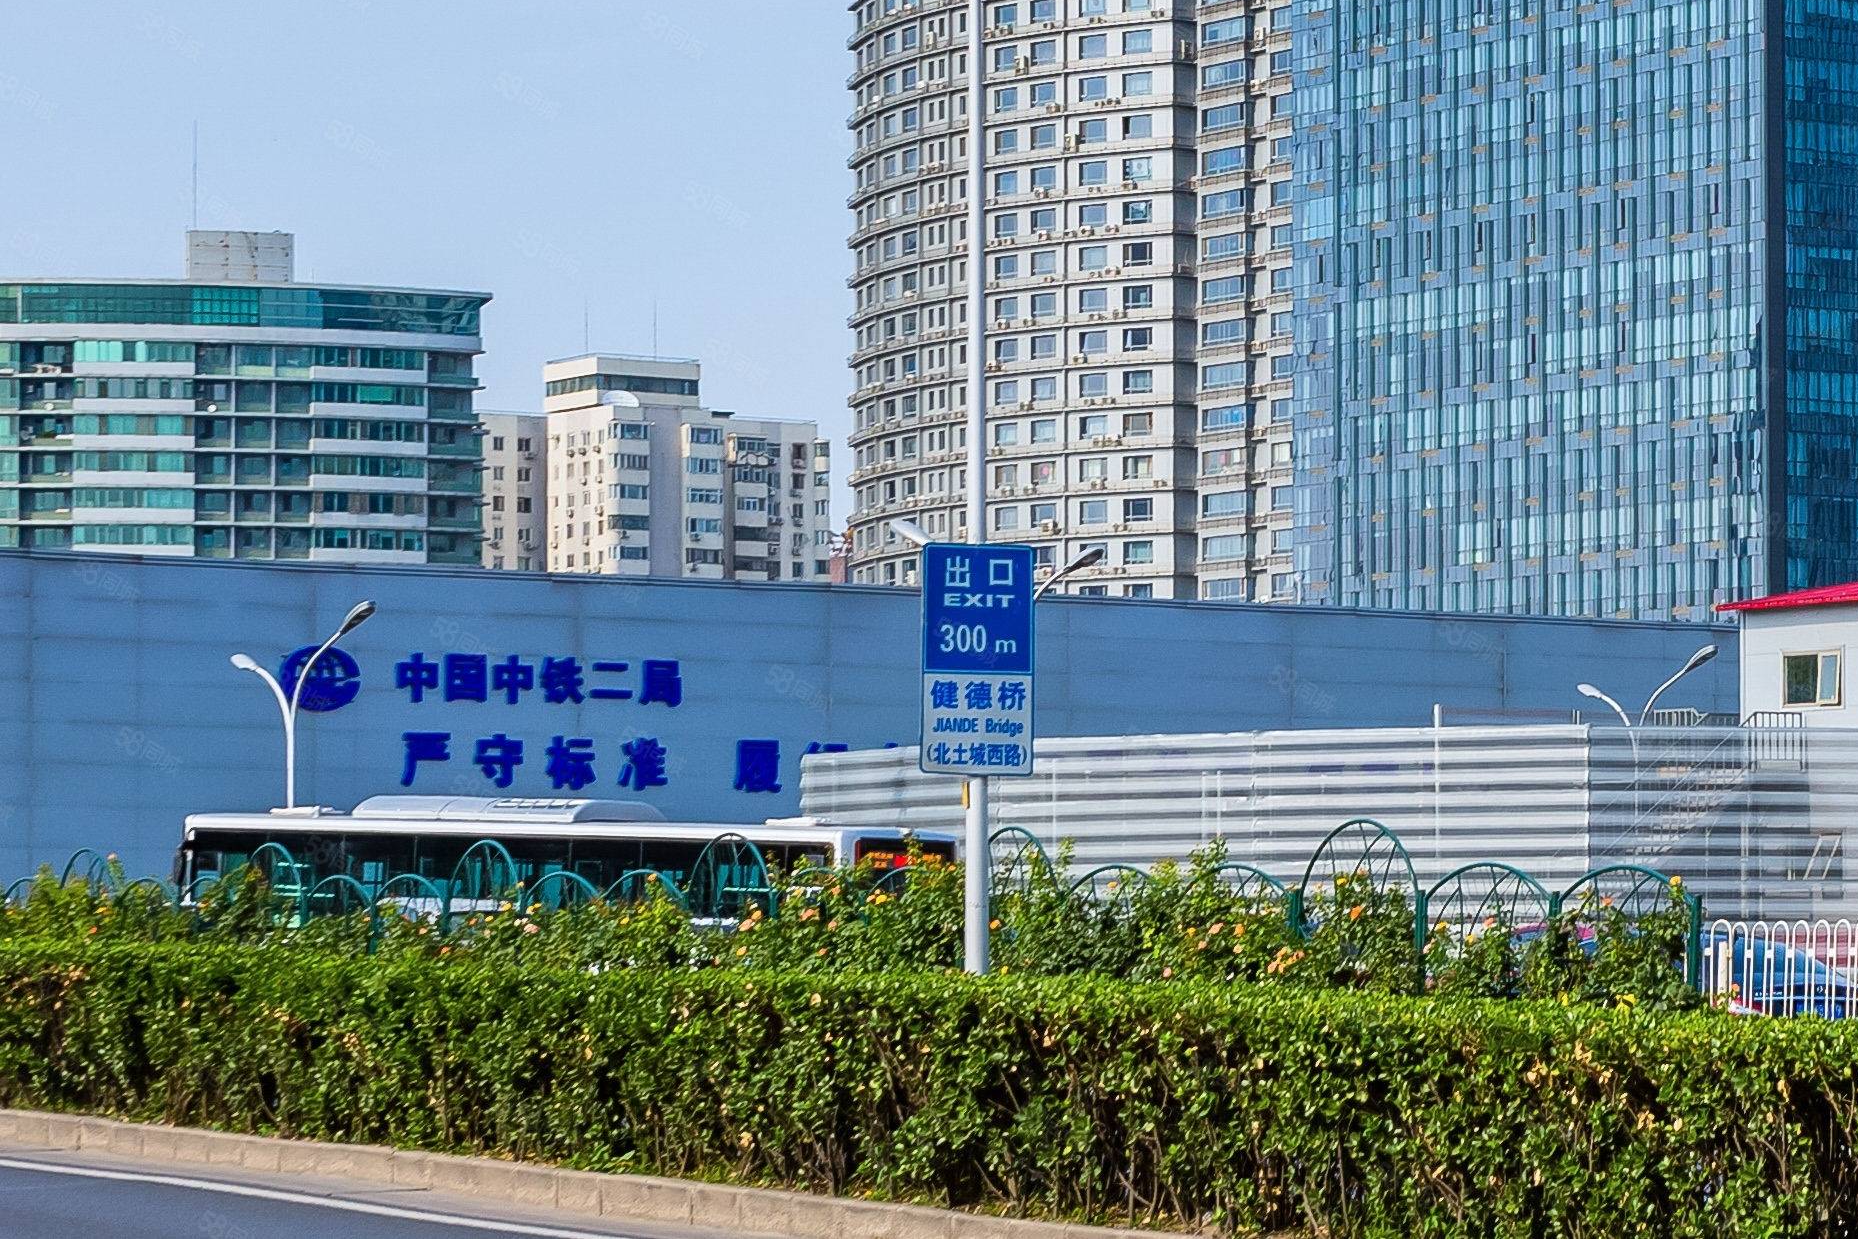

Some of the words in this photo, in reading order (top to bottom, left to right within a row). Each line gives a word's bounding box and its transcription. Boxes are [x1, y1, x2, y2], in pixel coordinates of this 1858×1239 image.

[944, 556, 1014, 588] 出口
[944, 593, 1015, 608] EXIT
[940, 624, 987, 653] 300
[995, 638, 1017, 654] m
[394, 652, 683, 708] 中国中铁二局
[930, 679, 1027, 711] 健德桥
[932, 718, 979, 734] JIANDE
[985, 717, 1024, 738] Bridge
